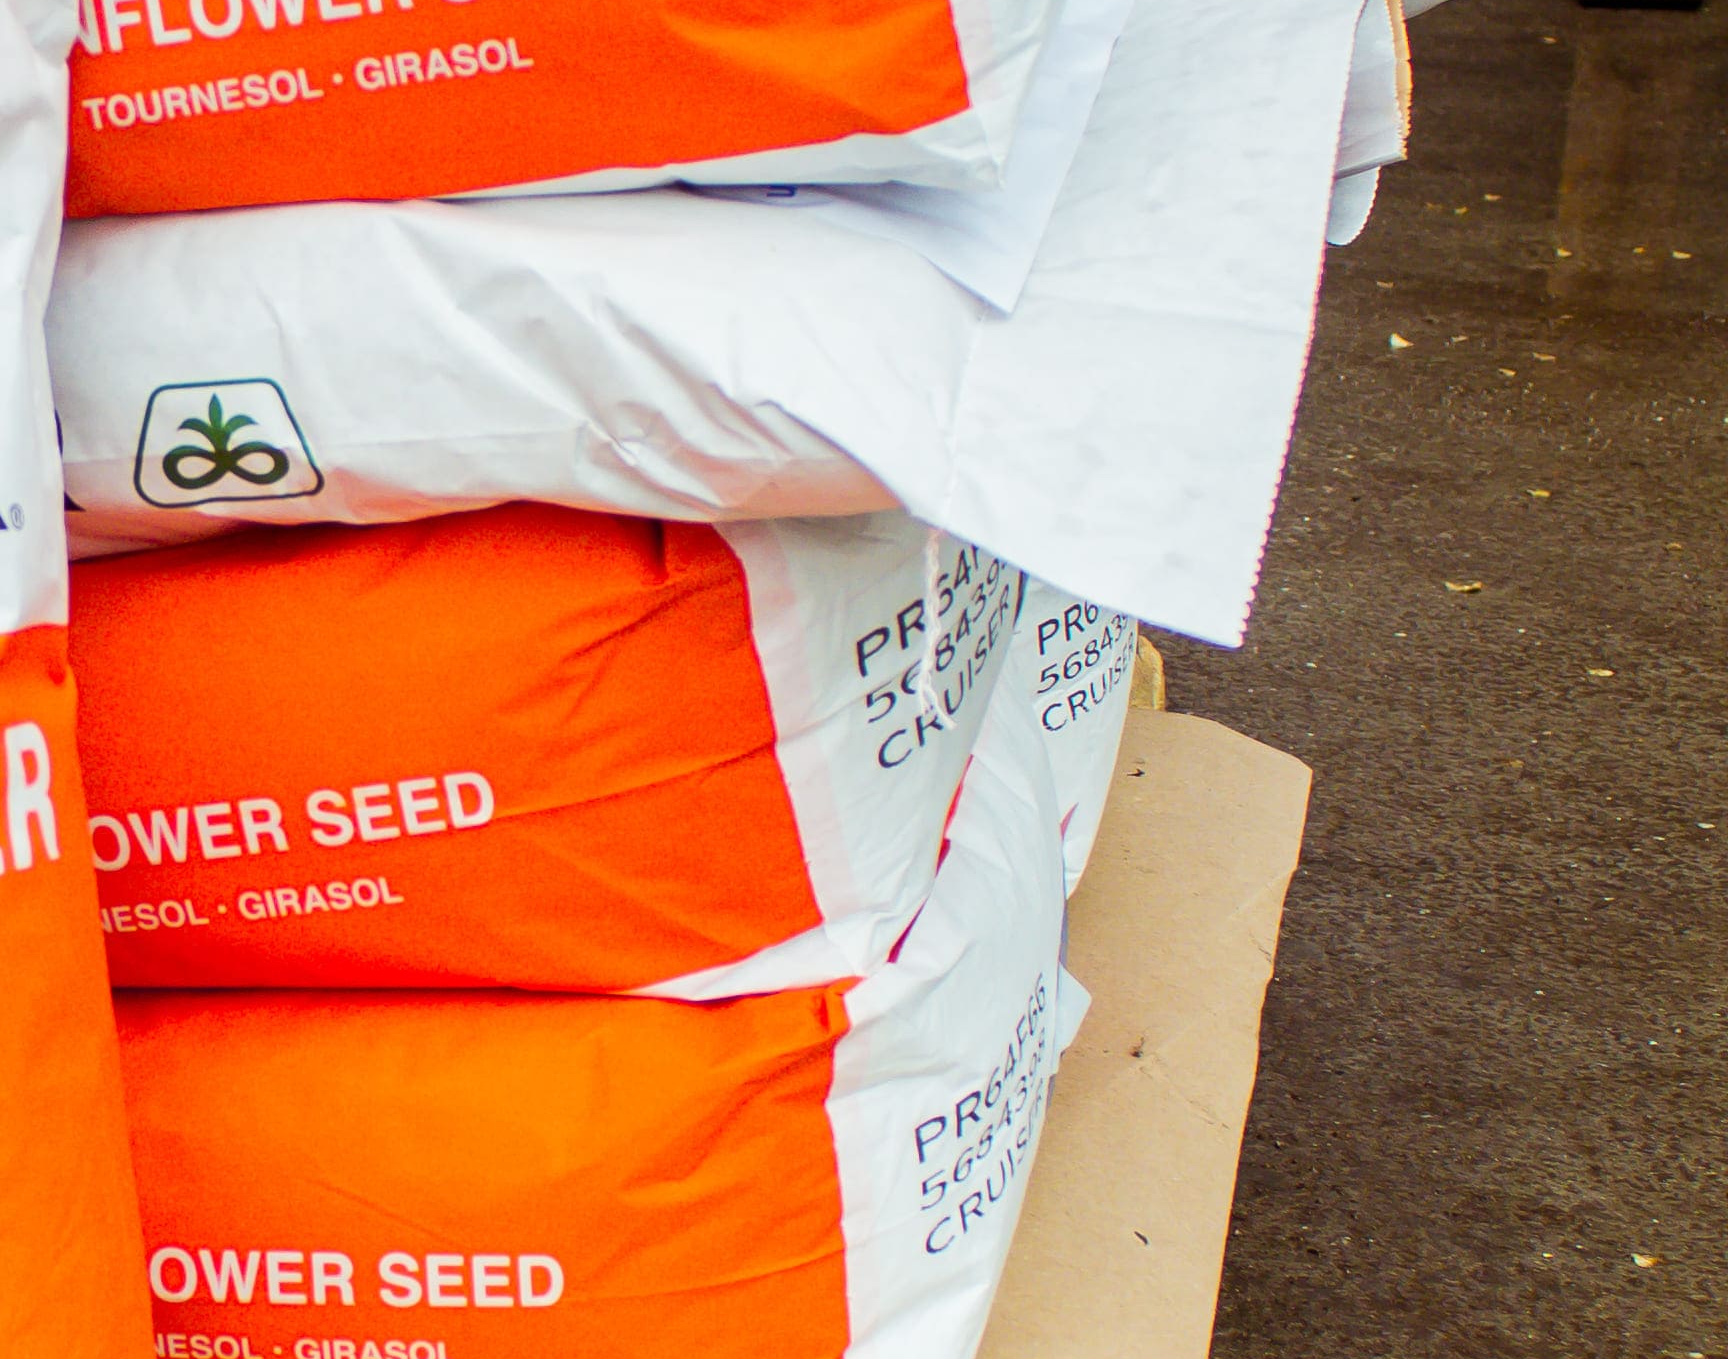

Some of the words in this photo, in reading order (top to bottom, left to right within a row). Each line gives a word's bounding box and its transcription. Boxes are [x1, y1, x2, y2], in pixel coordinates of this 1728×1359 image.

[81, 68, 323, 130] TOURNESOL
[354, 38, 534, 91] GIRASOL
[307, 772, 495, 847] SEED
[238, 877, 404, 920] GIRASOL
[379, 1252, 564, 1308] SEED
